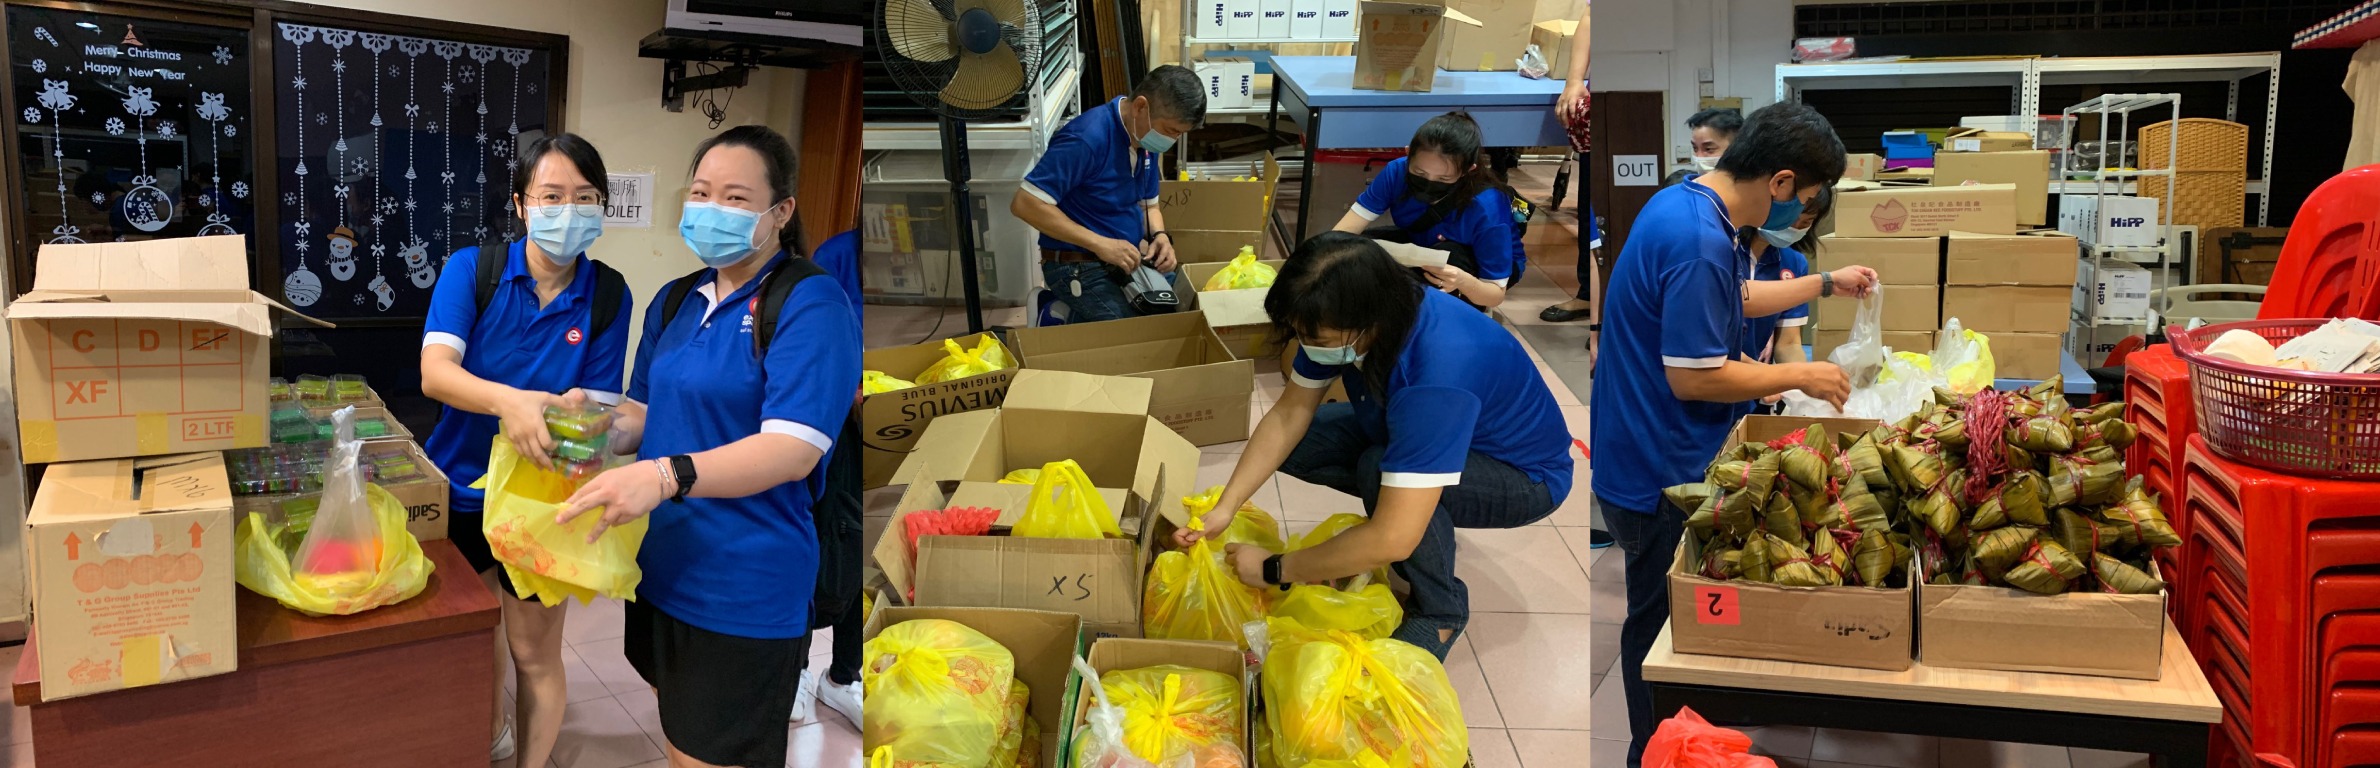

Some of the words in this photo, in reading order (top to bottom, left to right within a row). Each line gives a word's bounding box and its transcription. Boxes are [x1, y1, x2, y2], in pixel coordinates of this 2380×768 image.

[1215, 3, 1224, 27] HiPP
[1329, 10, 1349, 18] HiPP
[84, 44, 118, 58] Merry
[127, 47, 182, 61] Christmas
[84, 61, 121, 76] Happy
[128, 67, 154, 78] New
[159, 68, 186, 80] Year
[1211, 75, 1219, 98] HiPP
[1240, 75, 1249, 96] HiPP
[1617, 163, 1654, 178] OUT
[605, 204, 643, 218] OILET
[2110, 217, 2145, 228] HiPP
[2097, 282, 2106, 305] HiPP
[71, 329, 96, 354] C
[138, 329, 161, 352] D
[191, 328, 231, 351] EF
[65, 380, 108, 405] XF
[942, 373, 1006, 393] ORIGINAL
[901, 387, 936, 401] BLUE
[901, 386, 1008, 422] MEVIUS
[188, 423, 199, 437] 2
[104, 596, 131, 604] Group
[134, 591, 169, 600] Supplies
[188, 586, 201, 594] Ltd
[1707, 592, 1723, 616] 2
